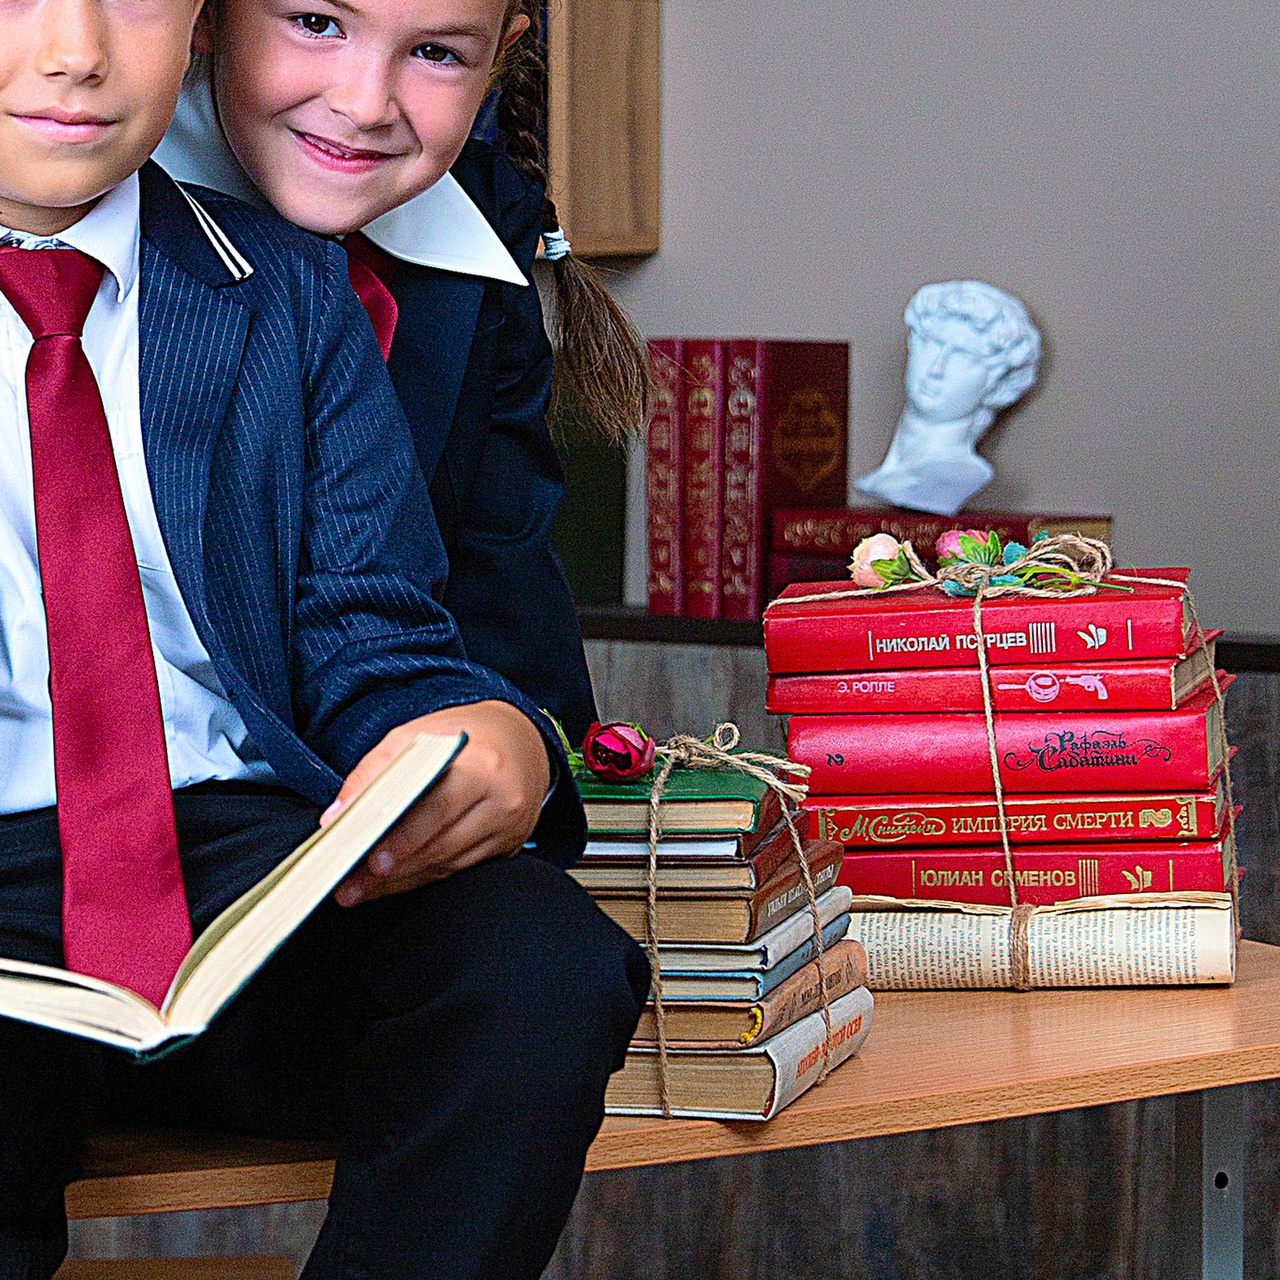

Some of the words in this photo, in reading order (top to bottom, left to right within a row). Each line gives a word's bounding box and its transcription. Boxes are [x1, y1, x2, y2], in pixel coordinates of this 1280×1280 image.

[876, 633, 950, 653] НИКОЛАЙ
[955, 632, 1027, 650] ПСРЦЕВ
[837, 681, 850, 693] Э.
[852, 681, 895, 693] РОЛЛЕ
[1053, 812, 1134, 830] СМЕРТИ
[920, 869, 984, 887] ЮЛИАН
